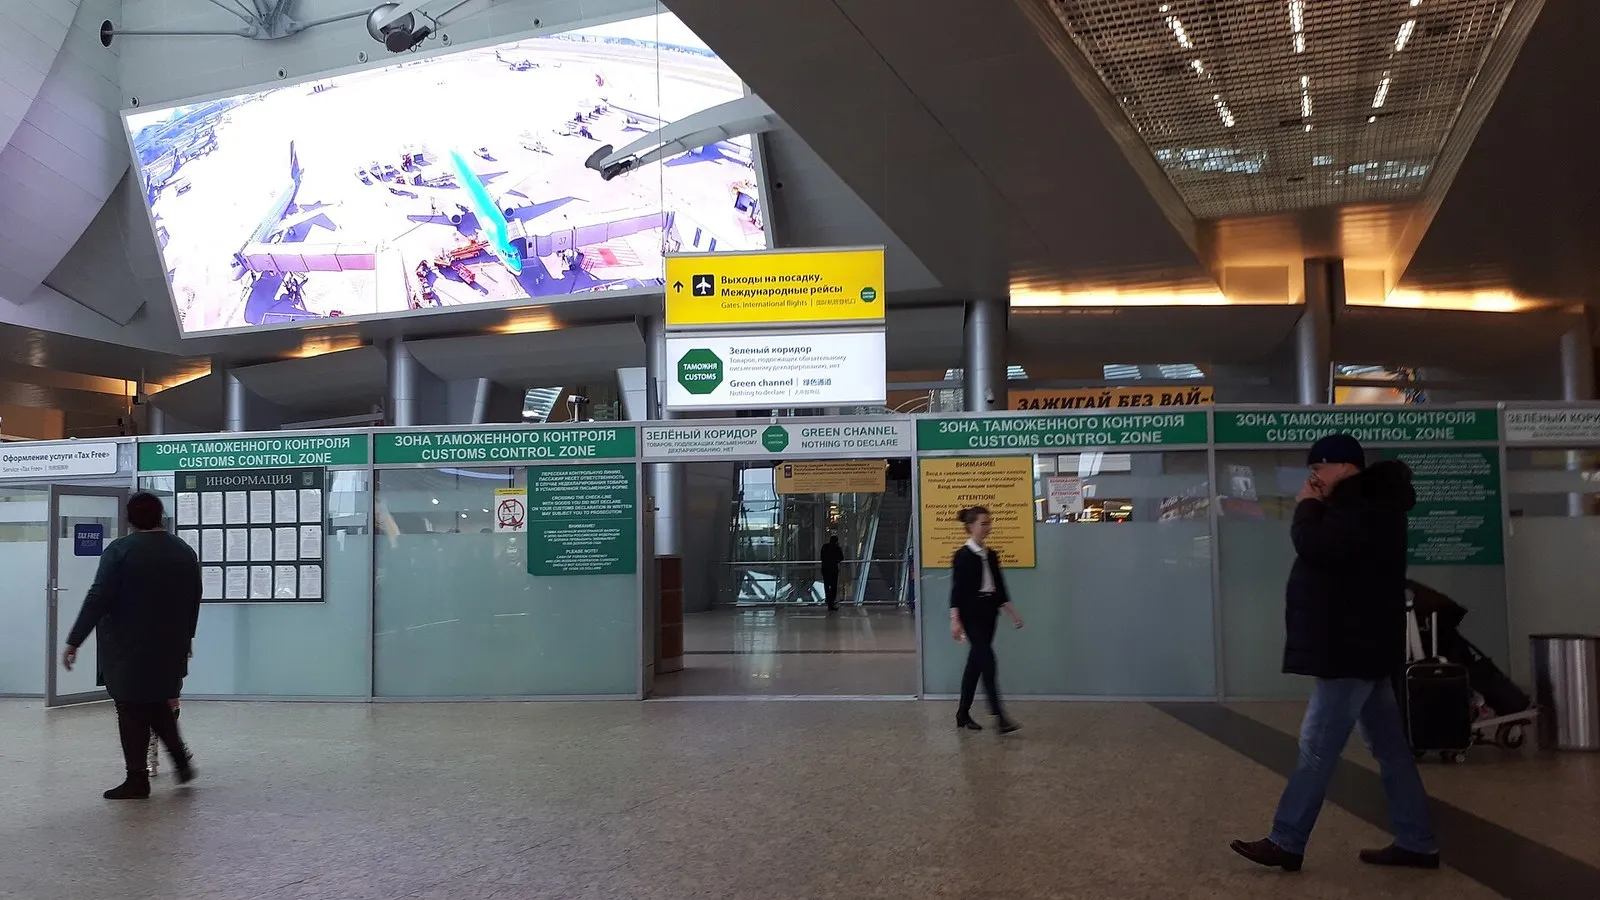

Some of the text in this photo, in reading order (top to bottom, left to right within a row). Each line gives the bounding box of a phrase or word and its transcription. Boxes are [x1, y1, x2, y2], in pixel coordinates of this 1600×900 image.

[721, 276, 762, 285] Выходы
[778, 274, 822, 284] посадку.
[721, 285, 843, 299] Международные рейсы
[786, 300, 808, 309] flights
[730, 346, 812, 355] Зеленый коридор
[683, 363, 718, 371] ТАМОЖНЯ
[730, 378, 793, 388] Green channel
[1017, 386, 1214, 410] ЗАЖИГАЙ БЕЗ ВАЙ-
[939, 415, 1184, 434] ЗОНА ТАМОЖЕННОГО КОНТРОЛЯ
[1235, 412, 1476, 426] ЗОНА ТАМОЖЕННОГО КОНТРОЛЯ
[394, 430, 616, 446] ЗОНА ТАМОЖЕННОГО КОНТРОЛЯ
[646, 428, 700, 440] ЗЕЛЁНЫЙ
[704, 428, 758, 440] КОРИДОР
[802, 426, 898, 438] GREEN CHANNEL
[1415, 427, 1456, 440] ZONE
[802, 438, 898, 448] NOTHING TO DECLARE
[968, 431, 1162, 448] CUSTOMS CONTROL ZONE
[156, 438, 350, 455] ЗОНА ТАМОЖЕННОГО КОНТРОЛЯ
[422, 445, 596, 460] CUSTOMS CONTROL ZONE
[3, 454, 48, 463] Оформление
[50, 454, 73, 462] услуги
[179, 452, 332, 468] CUSTOMS CONTROL ZONE
[206, 474, 292, 486] ИНФОРМАЦИЯ
